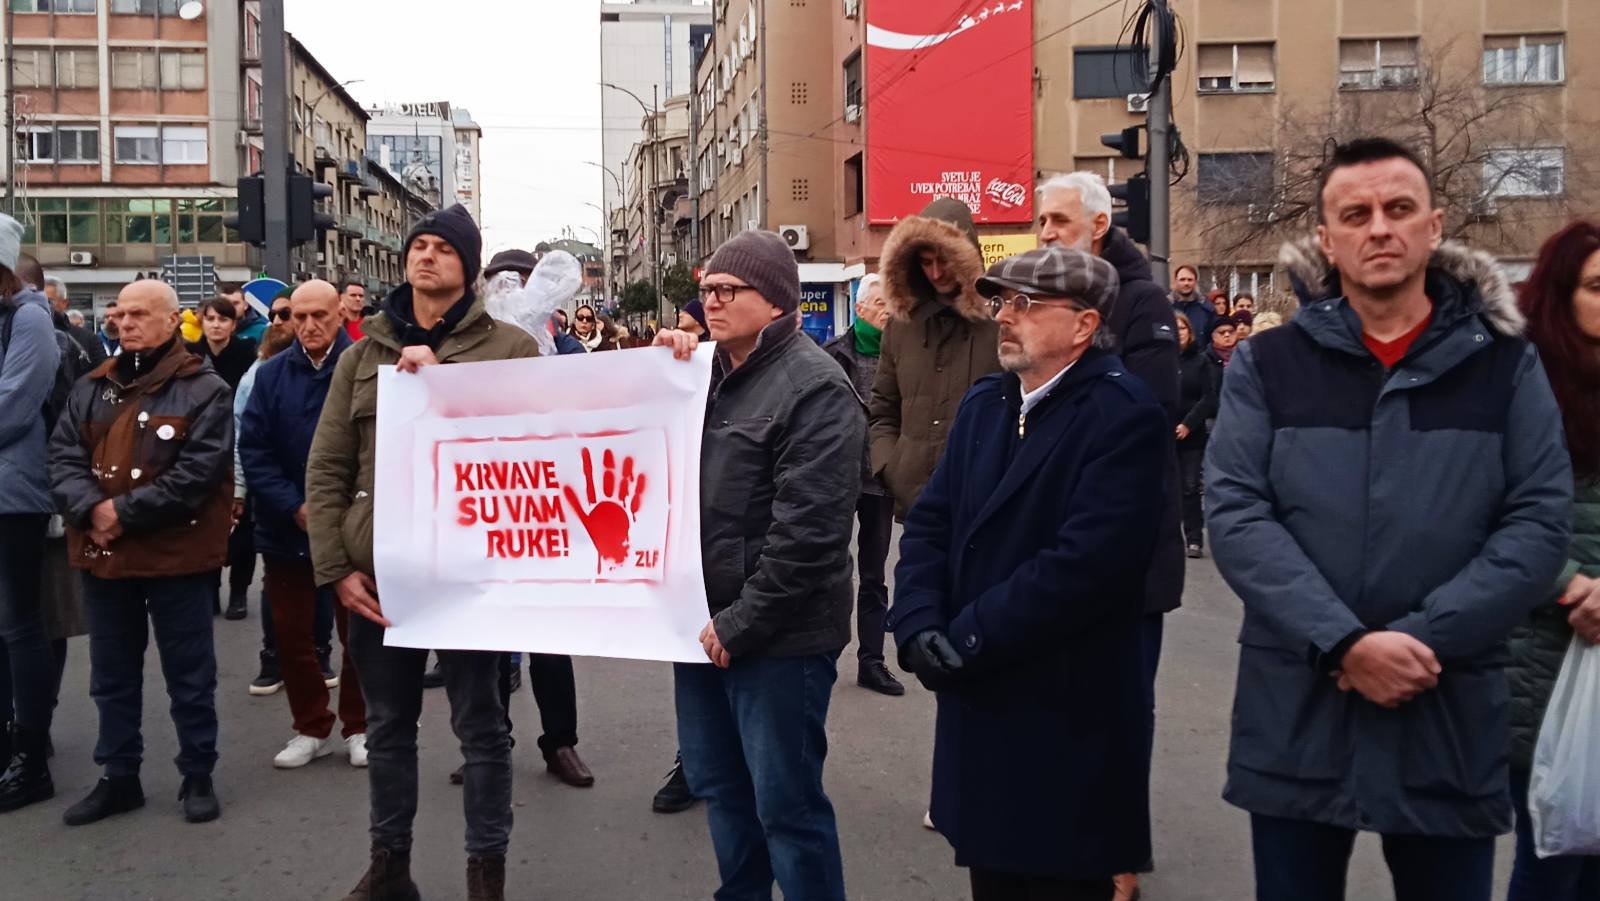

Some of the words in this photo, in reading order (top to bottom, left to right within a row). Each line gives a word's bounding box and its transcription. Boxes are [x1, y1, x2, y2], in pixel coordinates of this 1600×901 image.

[942, 172, 970, 182] SVETU
[911, 182, 934, 194] UVEK
[934, 182, 981, 194] POTREBAN
[983, 243, 1005, 253] ern
[985, 253, 1005, 264] ion
[799, 291, 827, 302] uper
[799, 302, 827, 312] ena
[455, 461, 560, 491] KRVAVE
[457, 496, 500, 526] SU
[503, 495, 566, 523] VAM
[486, 528, 570, 558] RUKE!
